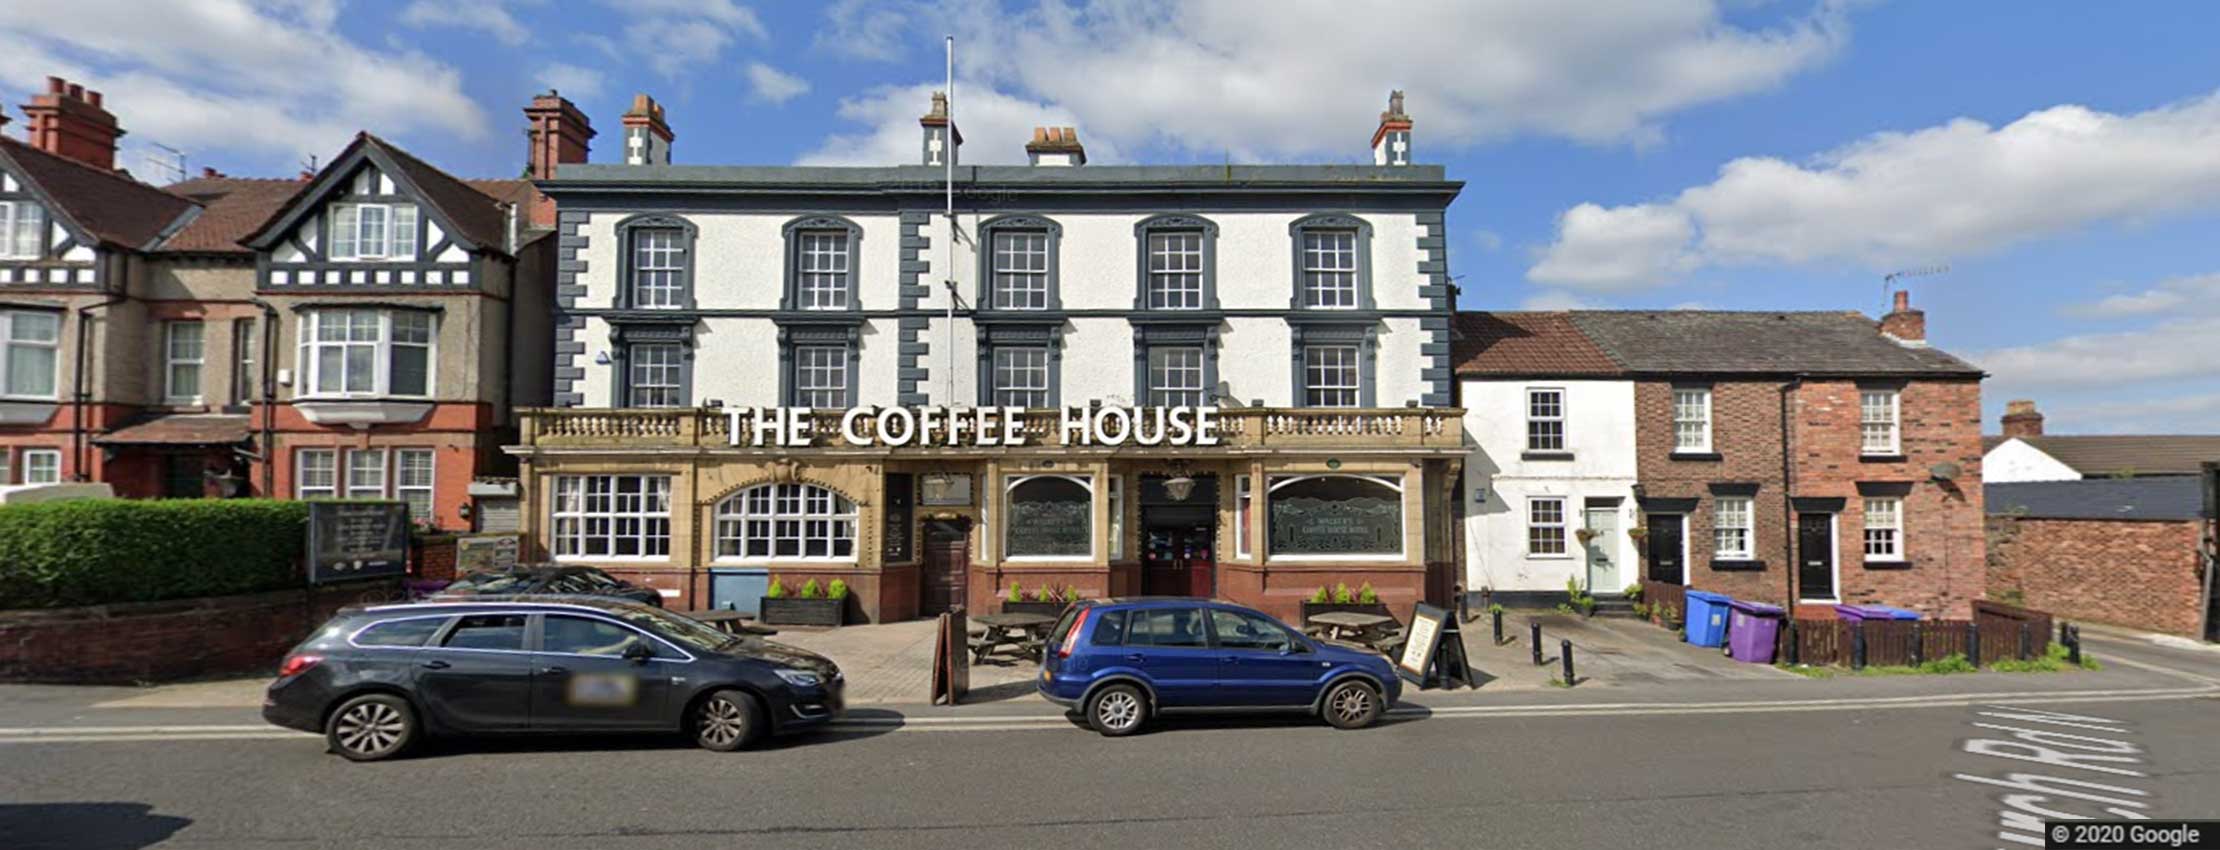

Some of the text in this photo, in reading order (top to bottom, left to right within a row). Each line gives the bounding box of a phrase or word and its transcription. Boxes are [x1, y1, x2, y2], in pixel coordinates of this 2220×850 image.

[721, 405, 1219, 447] THE COFFEE HOUSE
